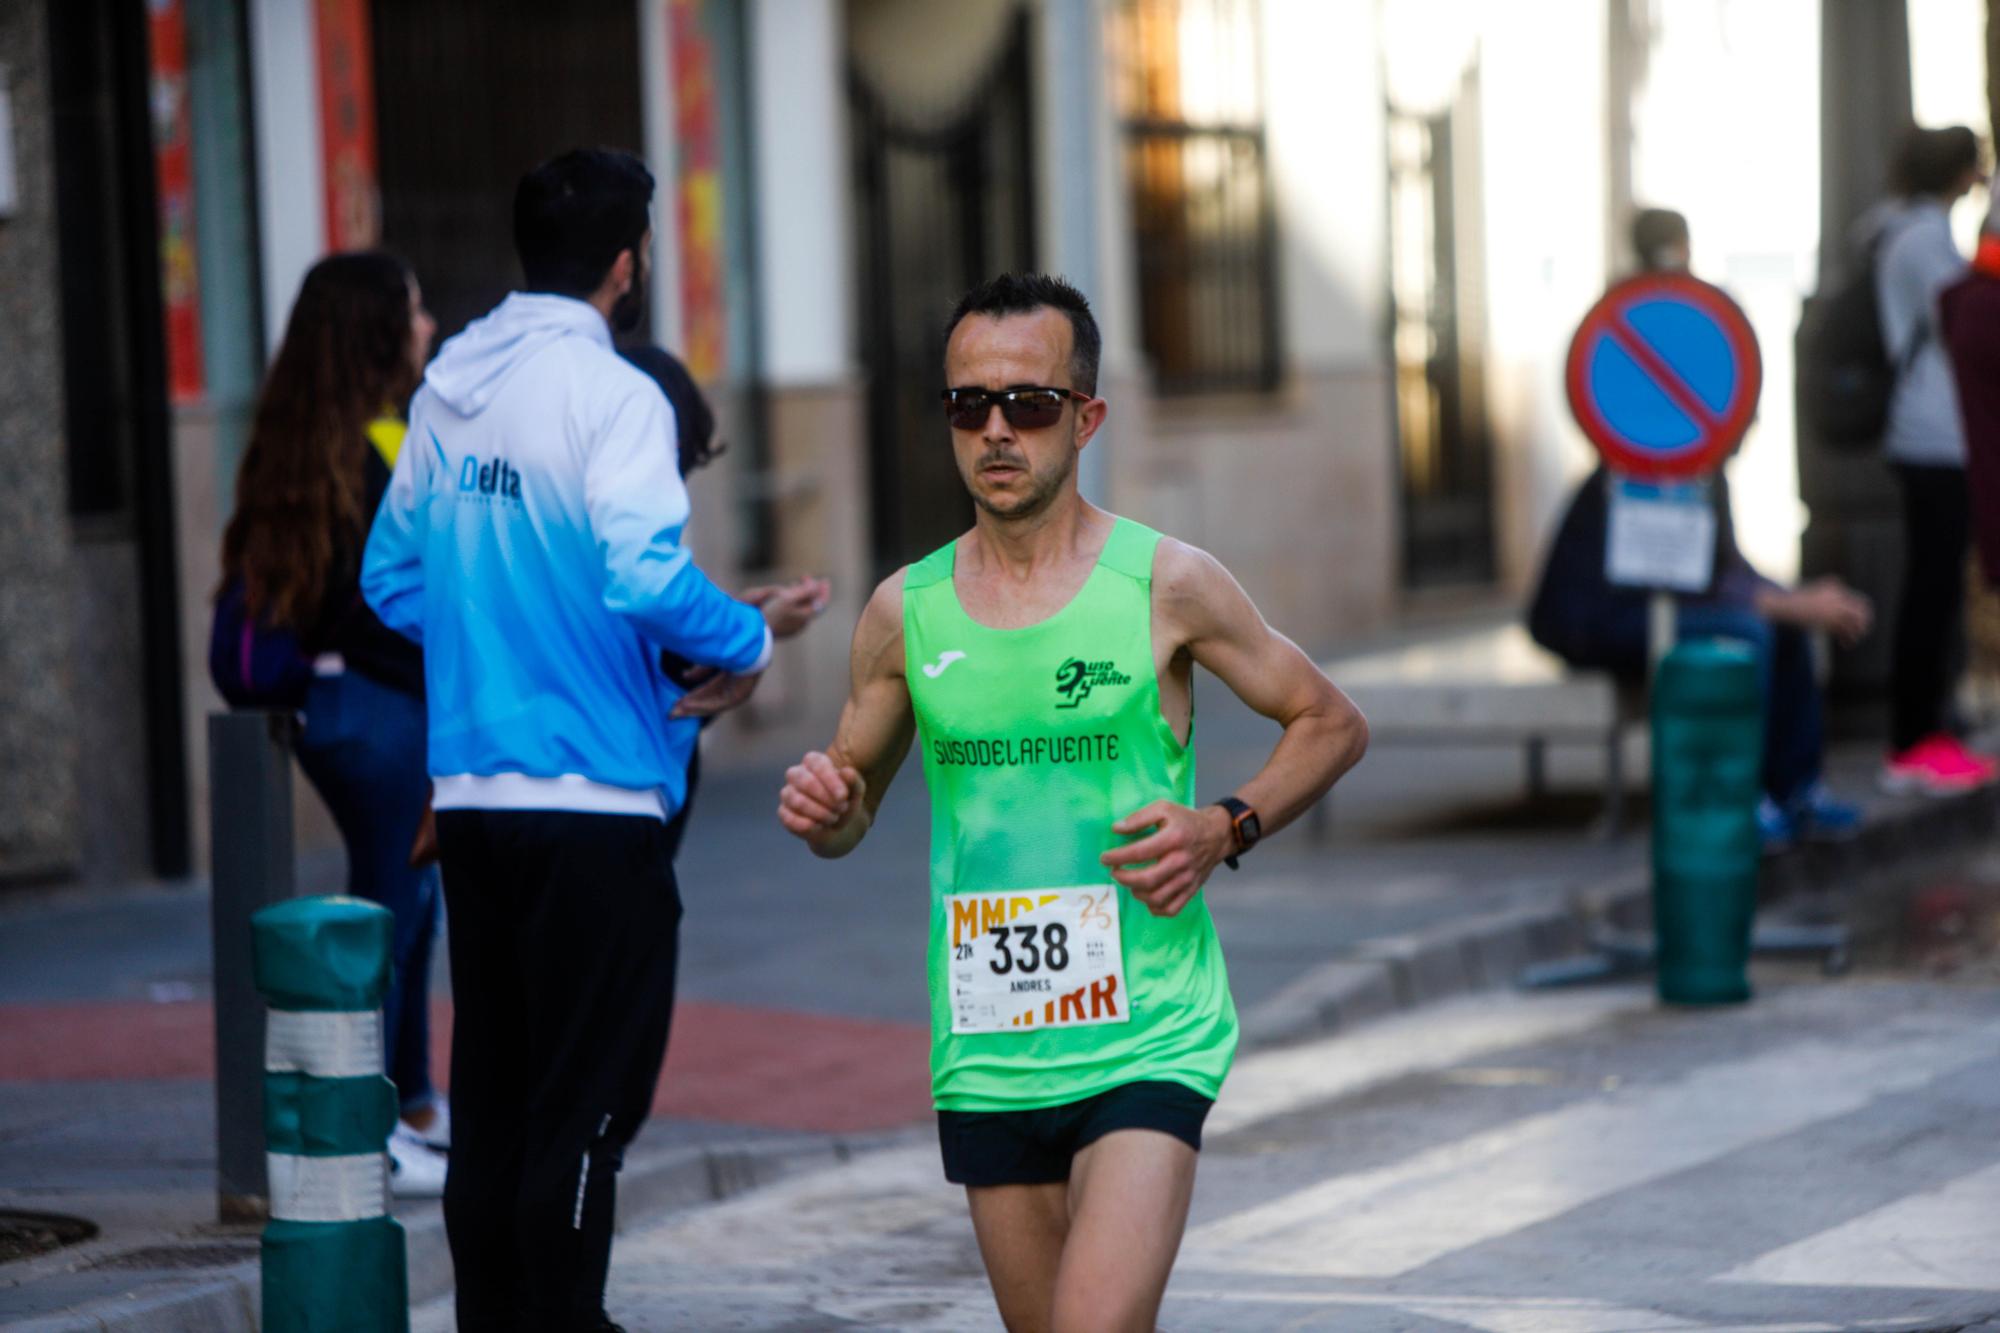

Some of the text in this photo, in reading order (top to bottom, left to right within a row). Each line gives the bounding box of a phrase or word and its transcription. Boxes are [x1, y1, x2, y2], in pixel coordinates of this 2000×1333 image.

[459, 455, 522, 501] Delta
[933, 733, 1120, 767] SUSODELAFUENTE
[988, 922, 1069, 975] 338
[1010, 979, 1052, 993] ANDRES
